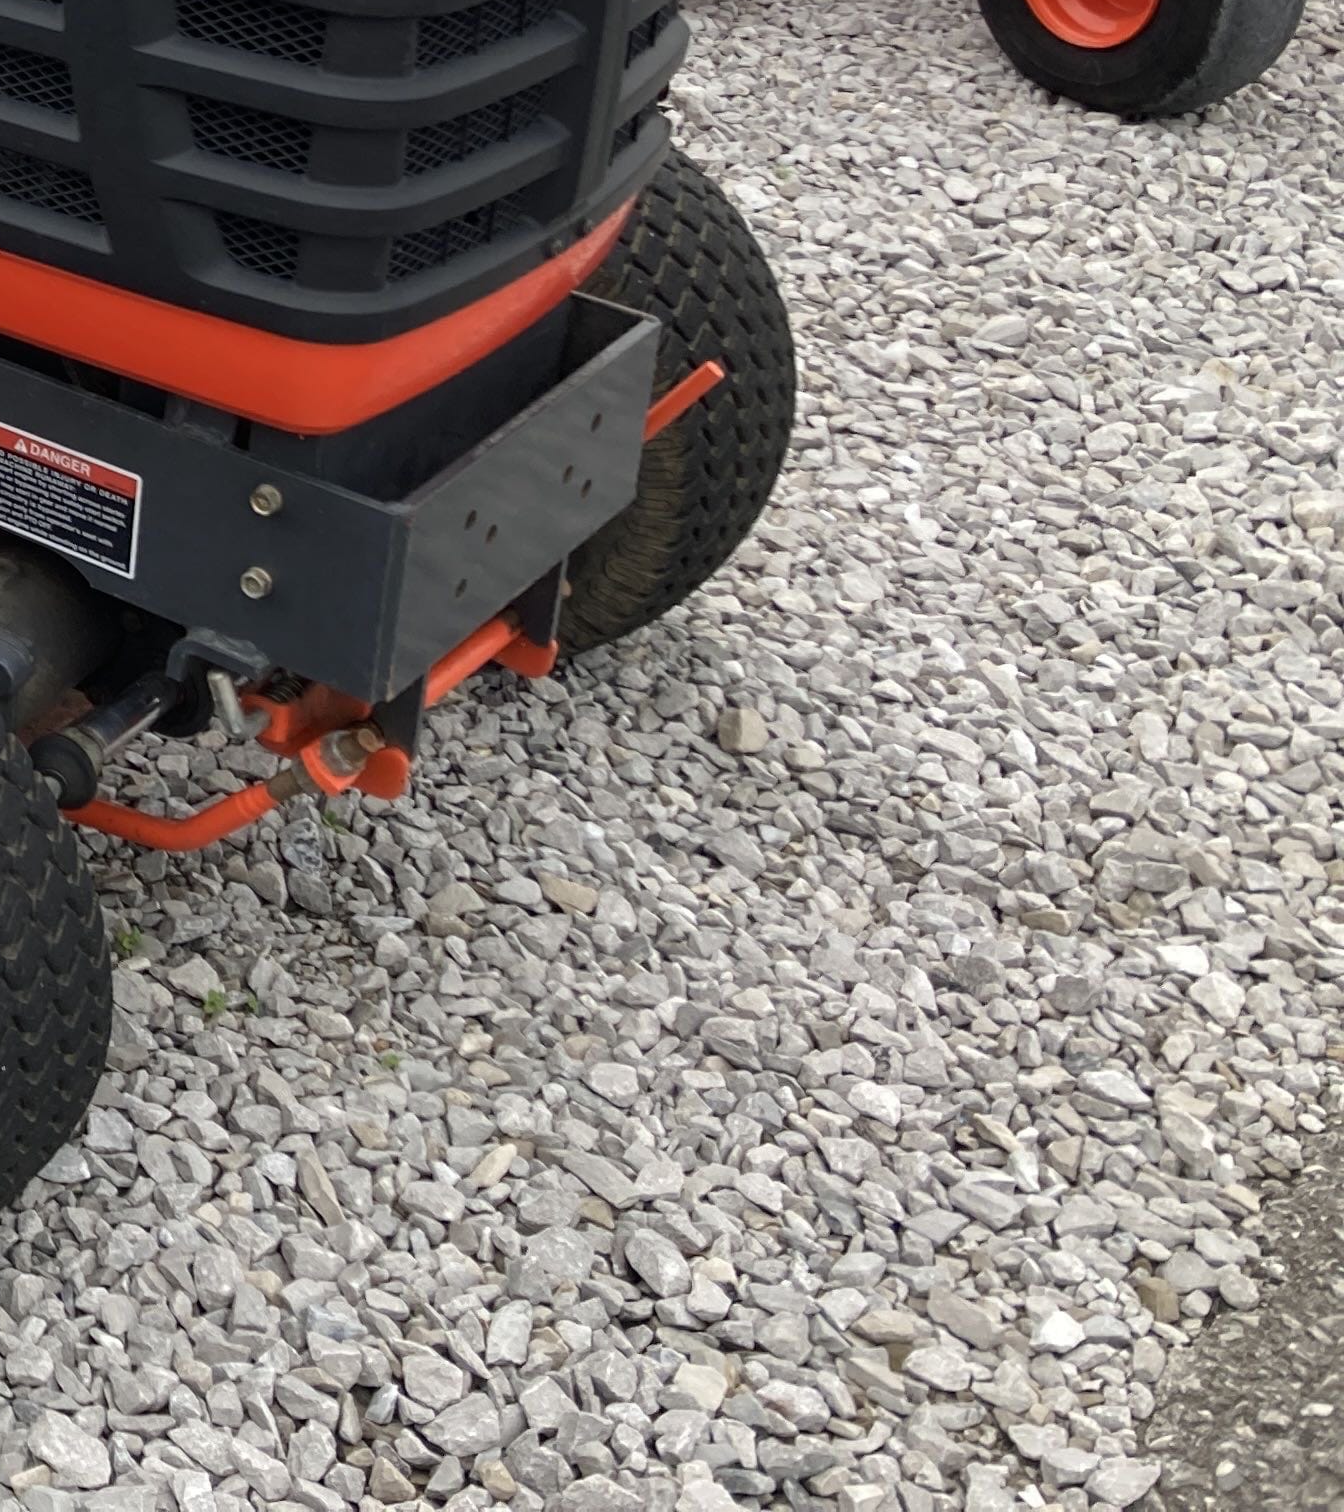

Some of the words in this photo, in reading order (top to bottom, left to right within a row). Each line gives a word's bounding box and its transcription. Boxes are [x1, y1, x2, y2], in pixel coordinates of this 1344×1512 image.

[6, 451, 48, 475] POSSIBLE
[50, 468, 81, 487] INJURY
[98, 487, 128, 506] DEATH
[29, 442, 91, 477] DANGER
